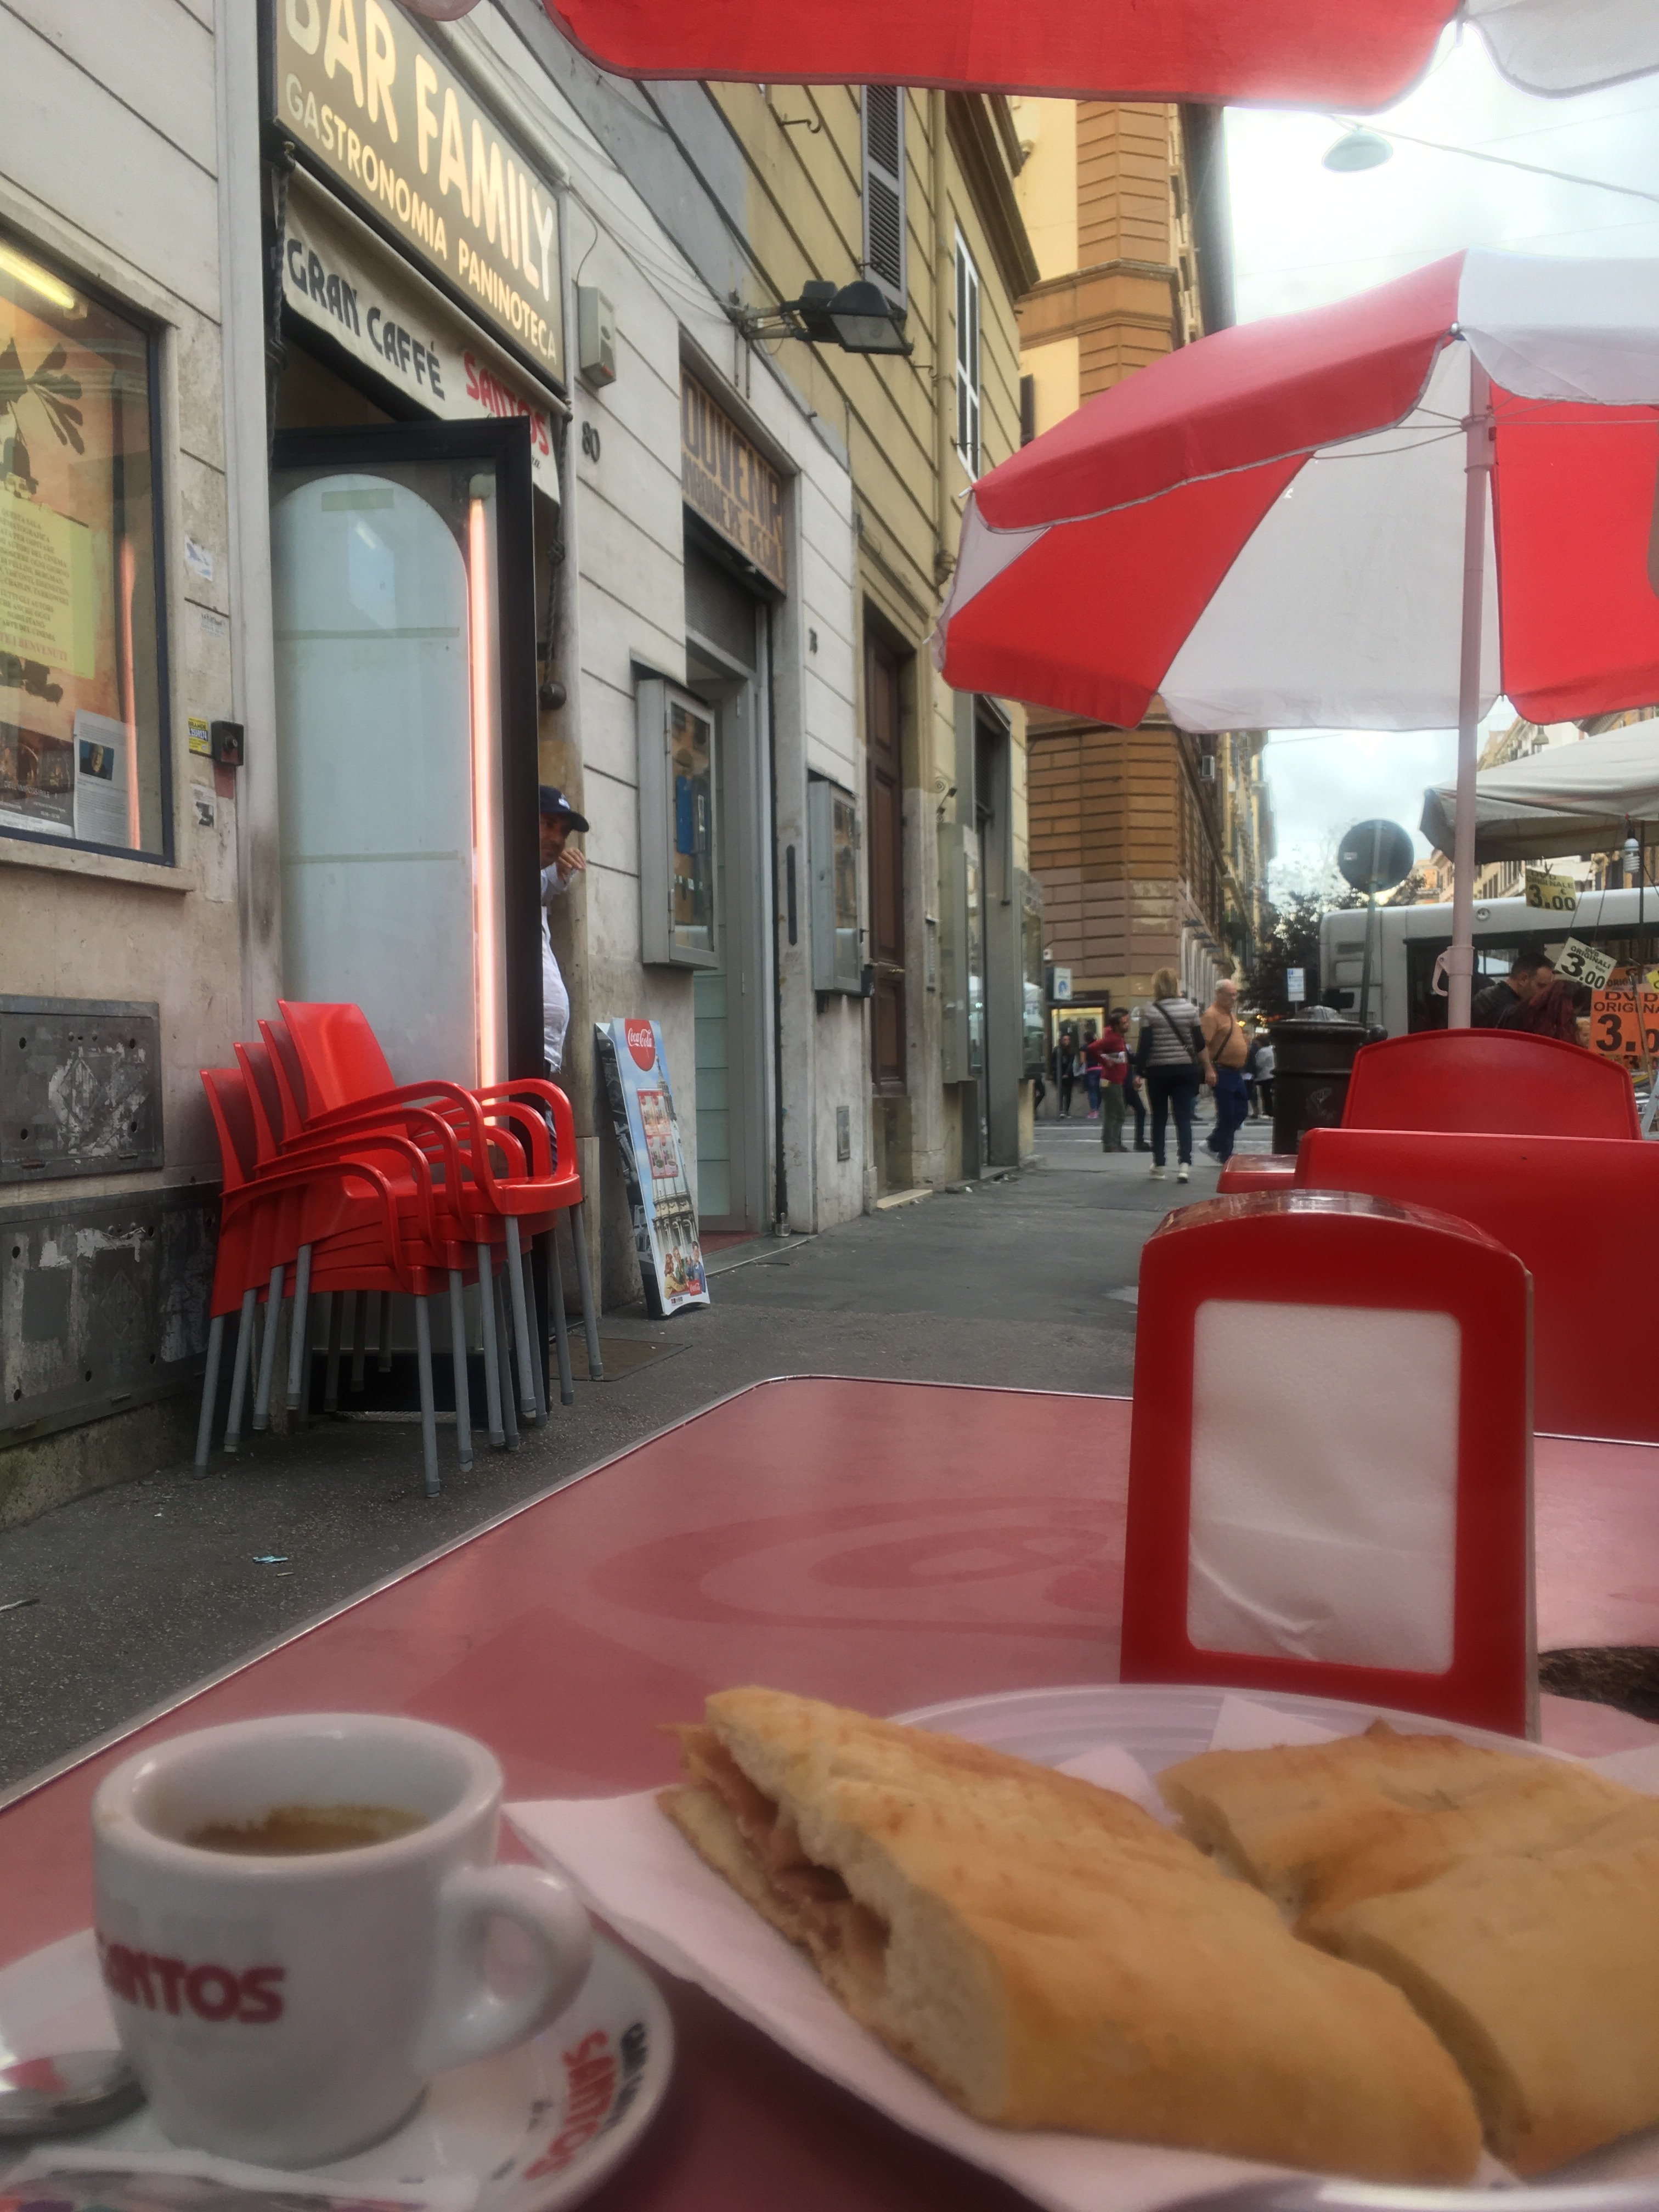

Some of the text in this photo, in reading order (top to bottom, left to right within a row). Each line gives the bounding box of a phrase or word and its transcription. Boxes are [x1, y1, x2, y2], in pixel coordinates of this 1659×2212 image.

[415, 54, 553, 301] FAMILY
[286, 73, 557, 365] GASTRONOMIA PANINOTECA
[286, 238, 360, 337] GRAN
[464, 351, 549, 456] SANTOS
[582, 421, 600, 463] 80
[19, 637, 67, 662] BENVENUTI
[1529, 884, 1576, 911] 3.00
[1561, 952, 1605, 989] 3.00
[1571, 945, 1611, 969] ORIGINALI
[1605, 991, 1658, 1002] DVD
[628, 1028, 652, 1047] Coca-Cola
